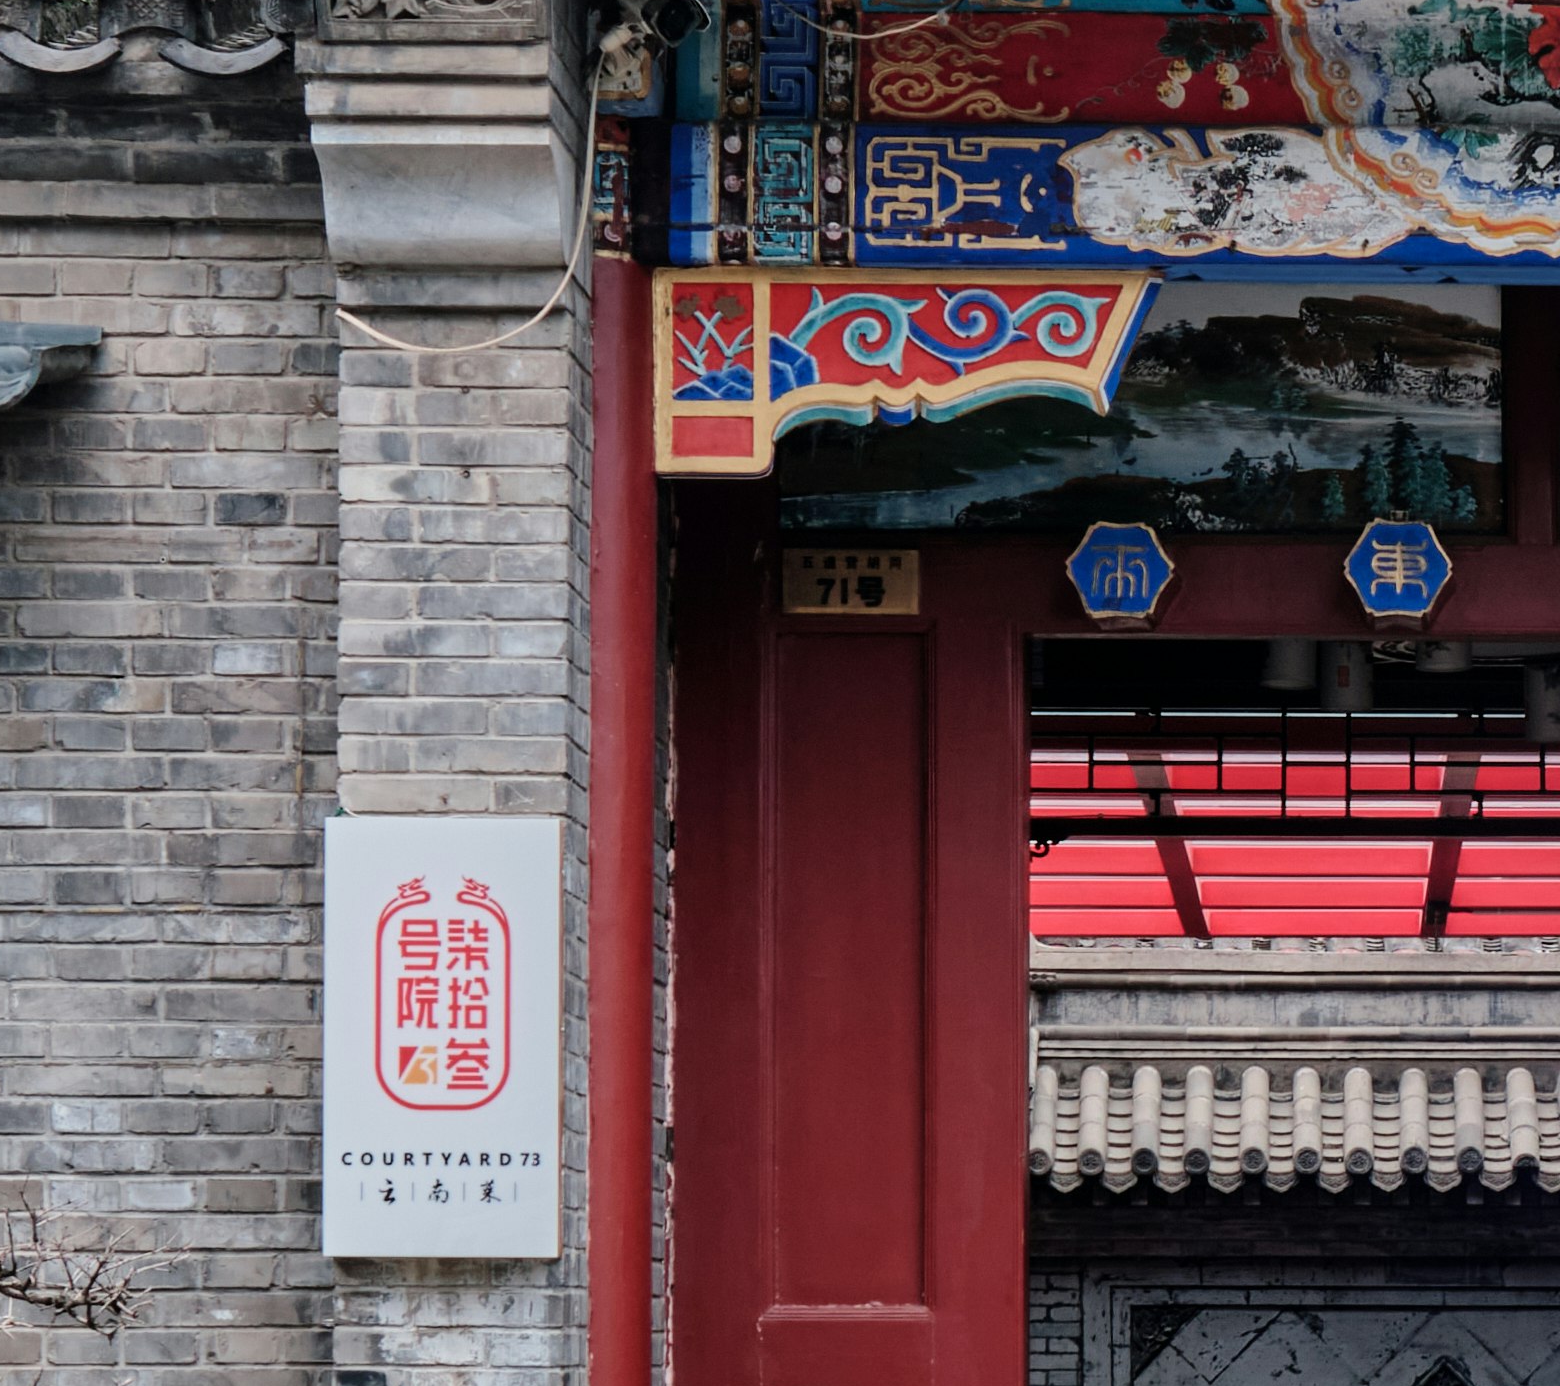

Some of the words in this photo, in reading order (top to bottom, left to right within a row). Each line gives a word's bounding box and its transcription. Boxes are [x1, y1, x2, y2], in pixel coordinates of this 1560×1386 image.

[816, 576, 886, 608] 71号
[396, 918, 440, 1029] 号院
[445, 918, 490, 1090] 柒拾叁
[341, 1152, 512, 1166] COURTYARD
[520, 1152, 541, 1166] 73
